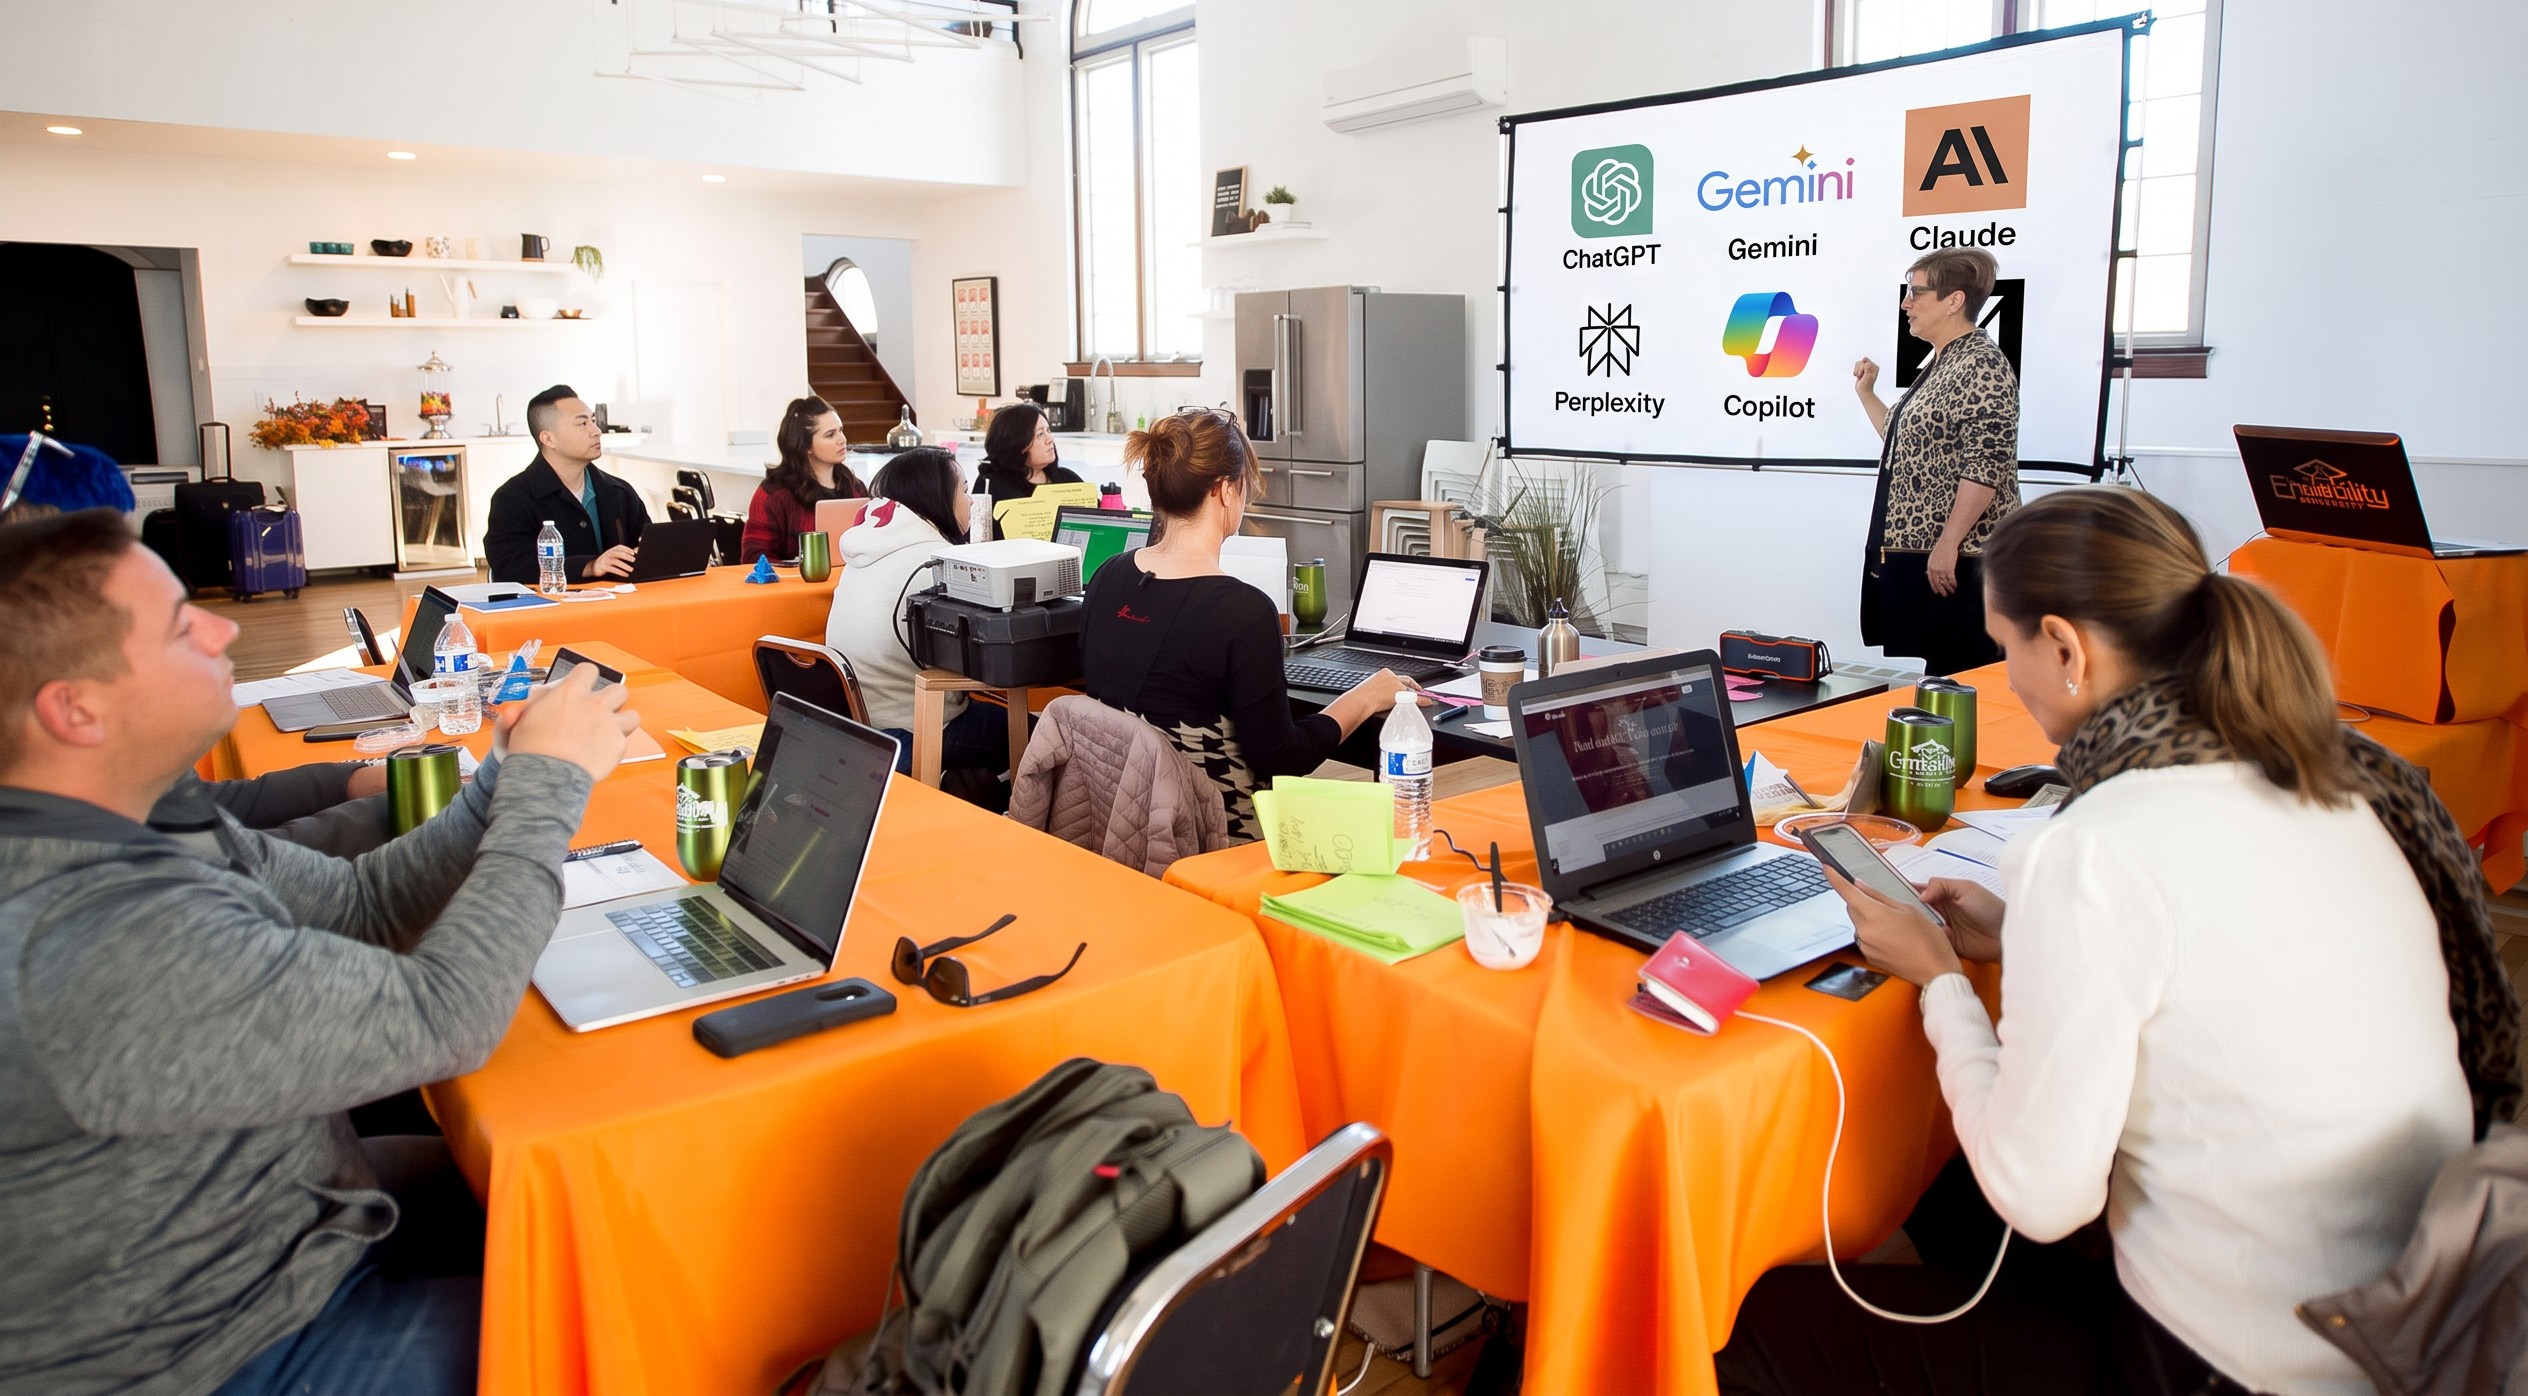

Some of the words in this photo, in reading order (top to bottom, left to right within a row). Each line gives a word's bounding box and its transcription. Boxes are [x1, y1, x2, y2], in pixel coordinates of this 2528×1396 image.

[1696, 157, 1855, 212] Gemini
[1727, 232, 1818, 261] Gemini
[1909, 221, 2017, 251] Claude
[1562, 243, 1662, 270] ChatGPT
[1554, 391, 1666, 419] Perplexity
[1723, 394, 1816, 422] Copilot
